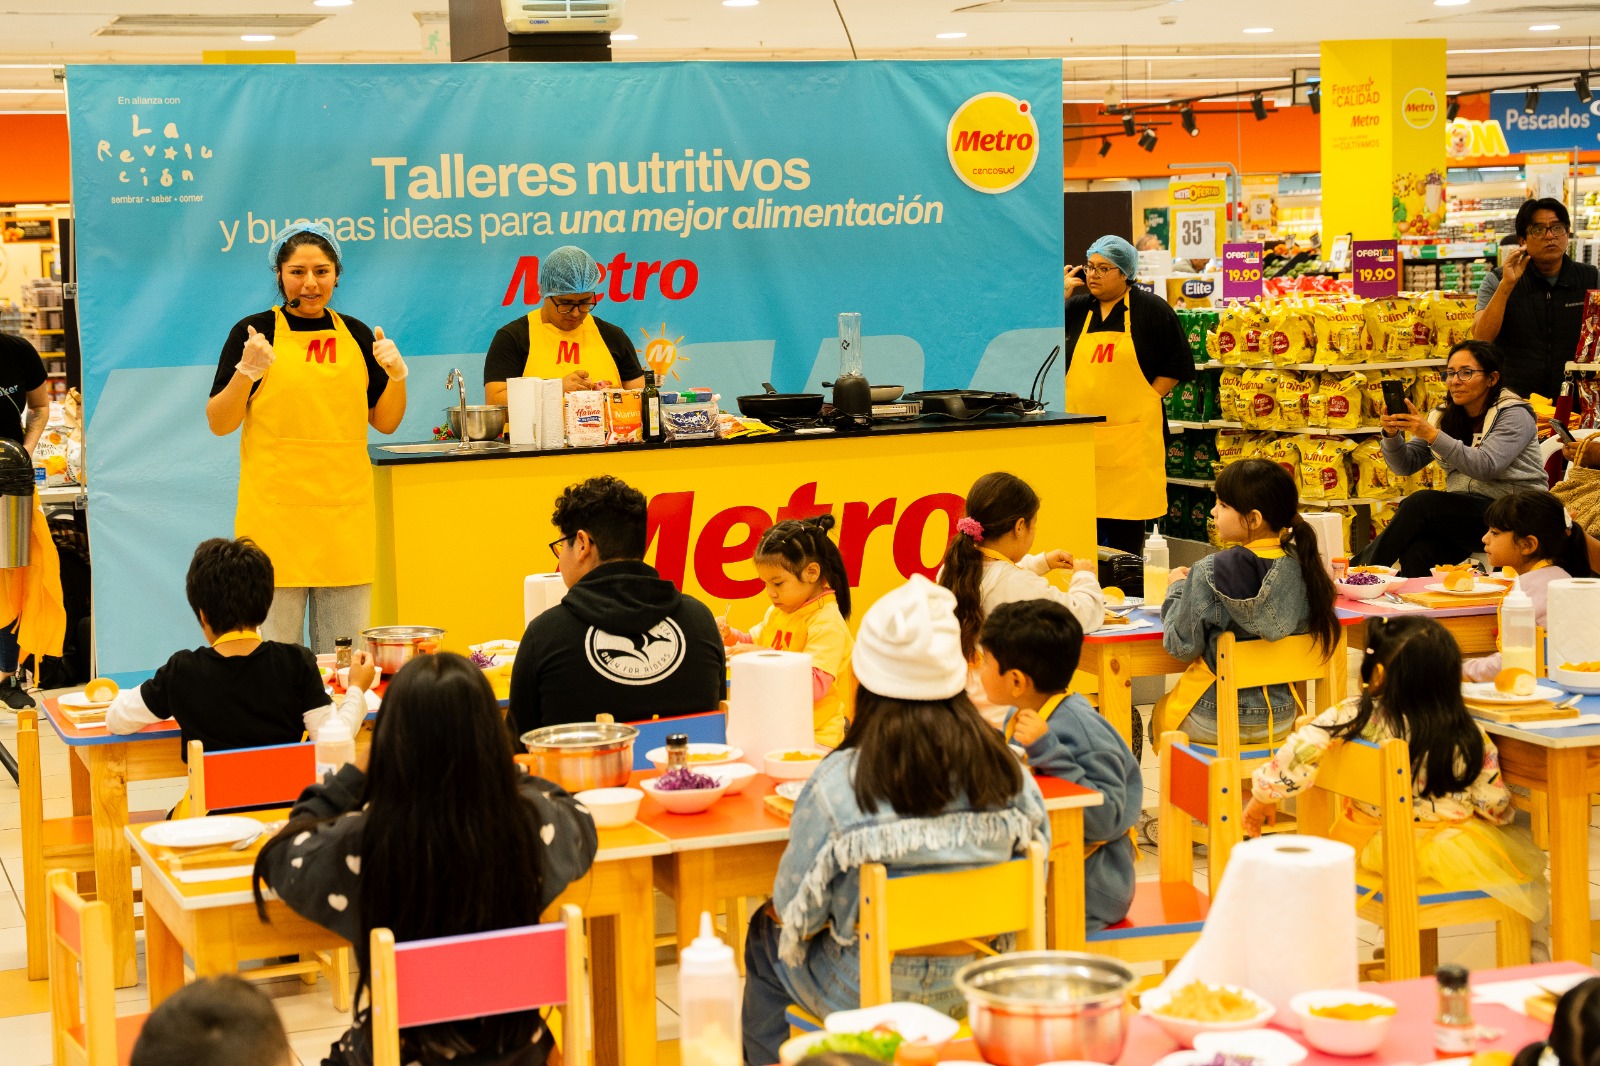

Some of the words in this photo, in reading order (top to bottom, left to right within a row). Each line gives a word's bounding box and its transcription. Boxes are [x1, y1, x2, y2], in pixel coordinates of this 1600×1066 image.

[118, 96, 130, 105] En
[132, 96, 163, 105] alianza
[164, 97, 181, 105] con
[1336, 91, 1380, 107] CALIDAD
[1404, 103, 1435, 112] Metro
[131, 114, 179, 138] La
[1350, 115, 1380, 128] Metro
[1505, 106, 1591, 131] Pescados
[954, 130, 1033, 152] Metro
[371, 153, 577, 200] Talleres
[587, 148, 811, 195] nutritivos
[972, 165, 1015, 175] cencosud
[111, 195, 144, 204] sembrar
[151, 194, 172, 203] saber
[179, 194, 204, 203] comer
[219, 219, 240, 252] y
[383, 208, 473, 240] ideas
[480, 210, 554, 244] para
[559, 209, 626, 235] una
[632, 200, 729, 238] mejor
[732, 194, 944, 230] alimentación
[1182, 220, 1202, 246] 35
[502, 251, 699, 307] Mtro
[1229, 268, 1260, 282] 19.90
[1360, 267, 1396, 282] 19.90
[1185, 281, 1212, 295] Elite
[306, 337, 336, 363] M
[557, 340, 580, 365] M
[648, 344, 674, 363] M
[1090, 343, 1115, 363] M
[601, 651, 620, 668] ONLY
[623, 666, 640, 674] FOR
[644, 653, 671, 673] RIDERS
